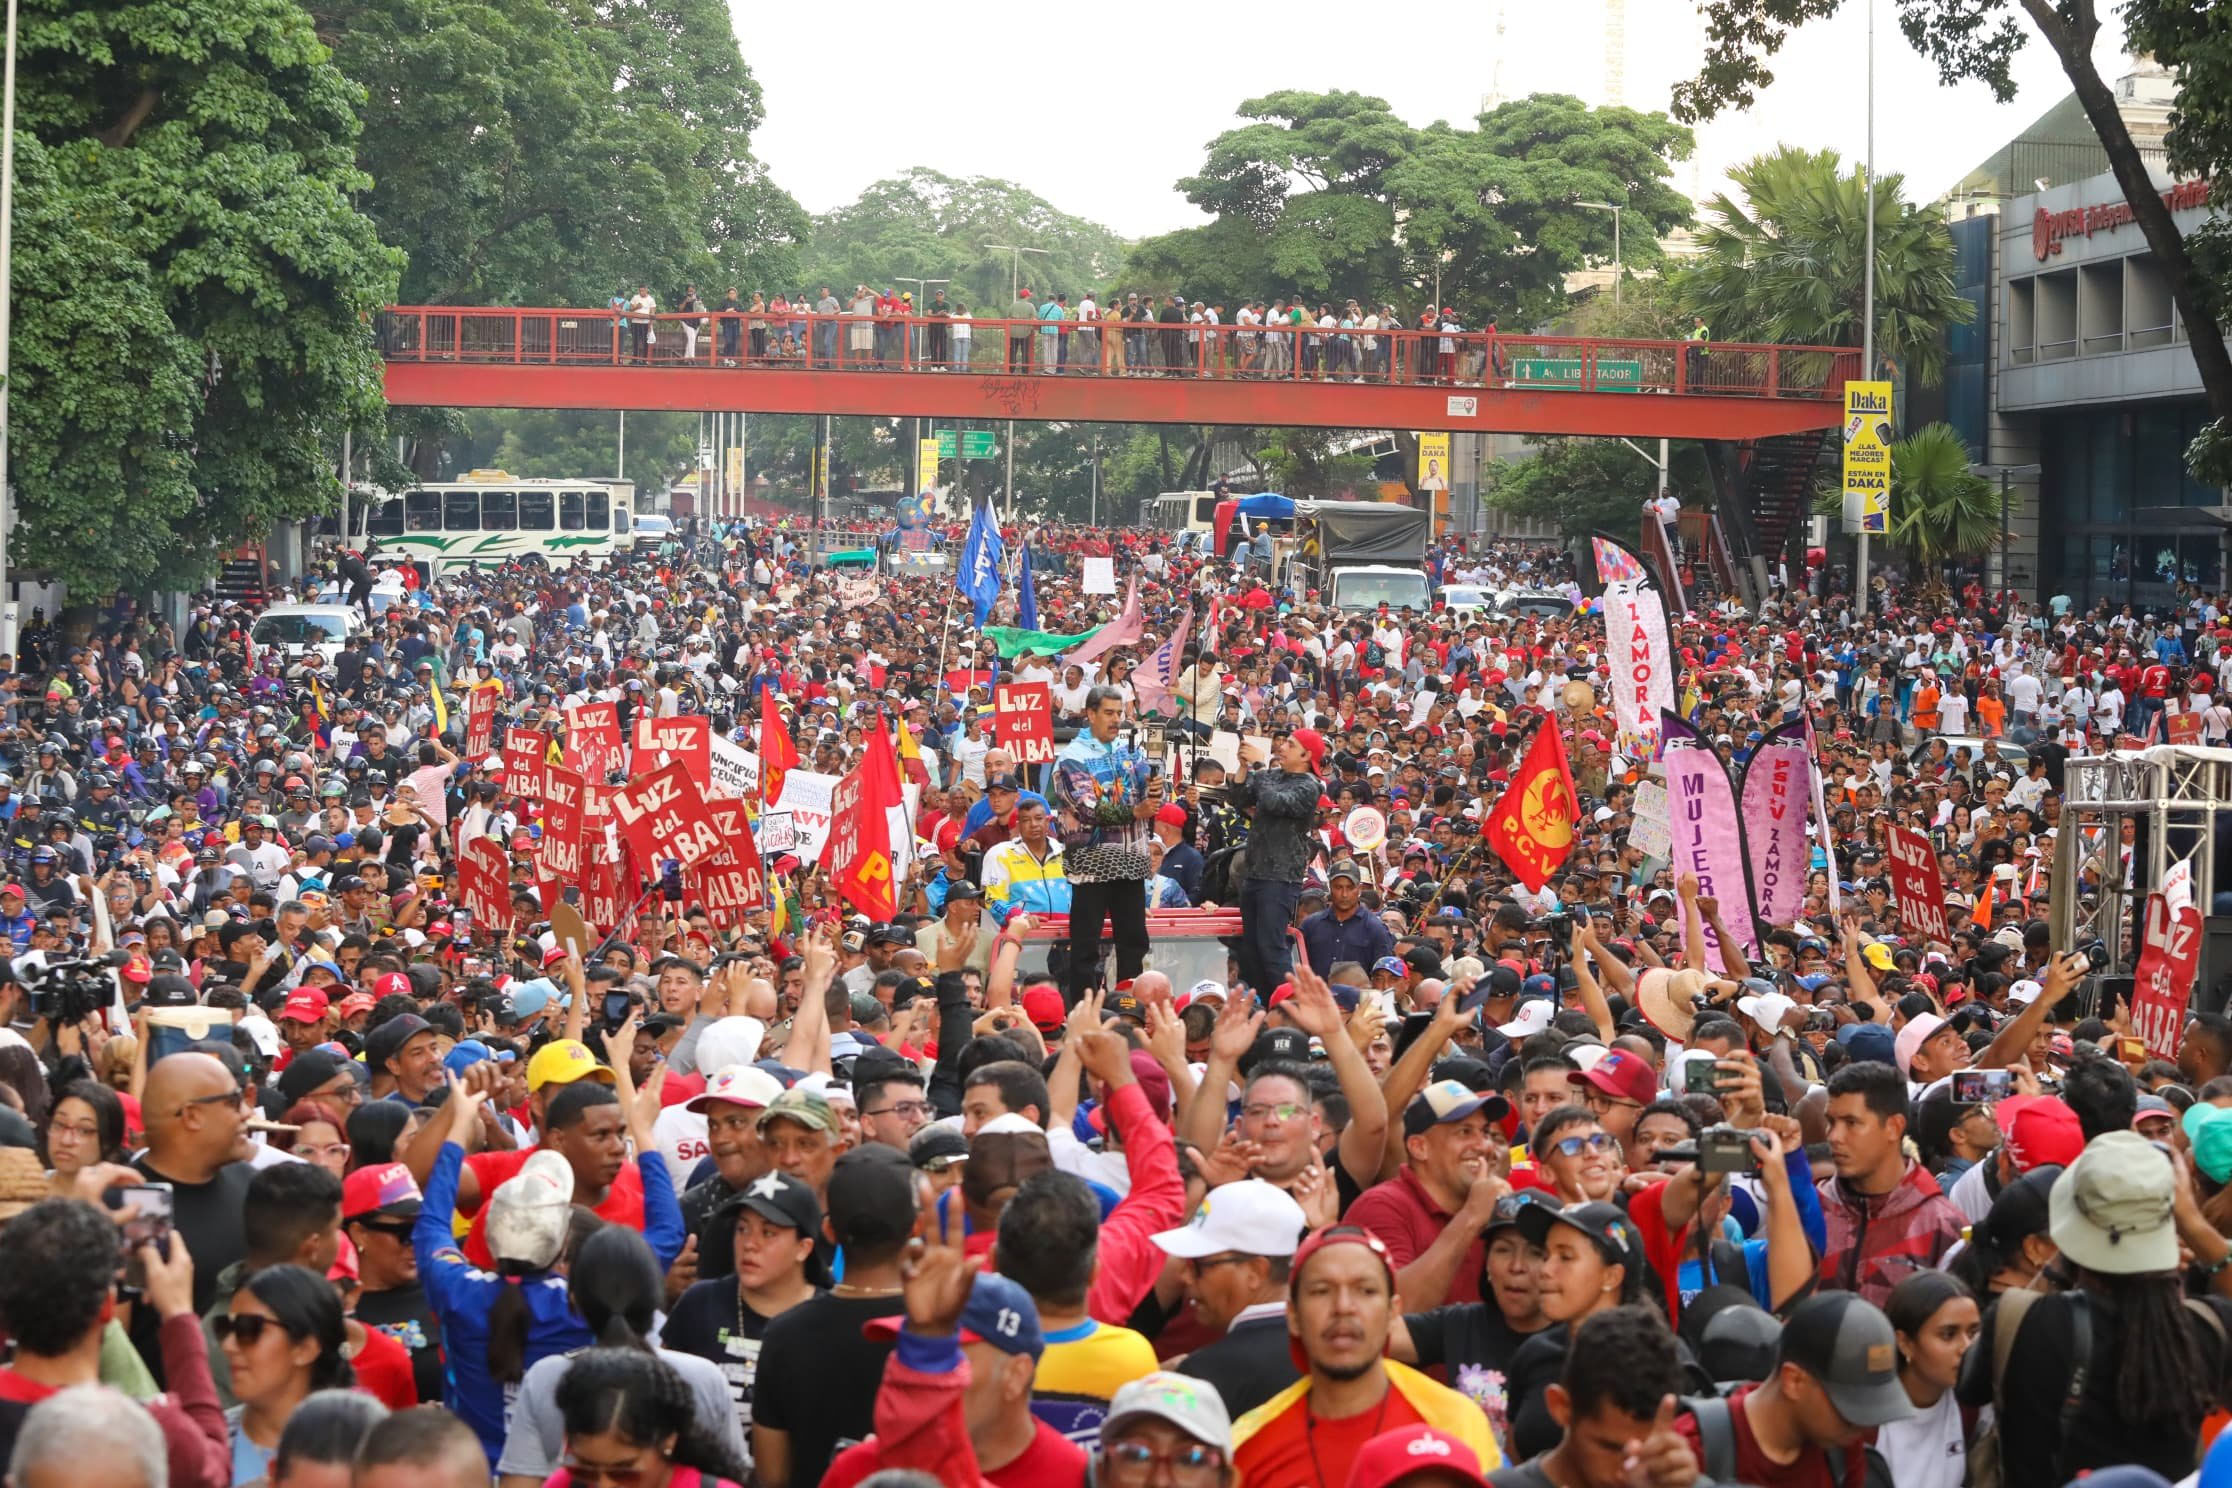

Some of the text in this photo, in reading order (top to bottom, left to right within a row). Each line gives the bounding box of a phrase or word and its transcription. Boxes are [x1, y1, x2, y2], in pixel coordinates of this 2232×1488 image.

[1564, 368, 1632, 379] LIBTADOR
[1851, 391, 1886, 410] Daka
[1848, 478, 1885, 489] DAKA
[1627, 602, 1654, 724] ZAMORA
[1011, 717, 1032, 732] del
[1003, 736, 1054, 764] ALBA
[504, 774, 541, 797] ALBA
[551, 810, 567, 831] del
[652, 810, 684, 839] del
[543, 835, 577, 873] ALBA
[651, 821, 720, 881] ALBA
[1682, 773, 1720, 948] MUJERS
[708, 867, 764, 908] ALBA
[1760, 828, 1780, 918] ZAMORA
[1905, 872, 1928, 897] del
[1902, 896, 1947, 940] ALBA
[2151, 963, 2172, 998] del
[2132, 1000, 2178, 1058] ALBA
[997, 1307, 1021, 1337] 13
